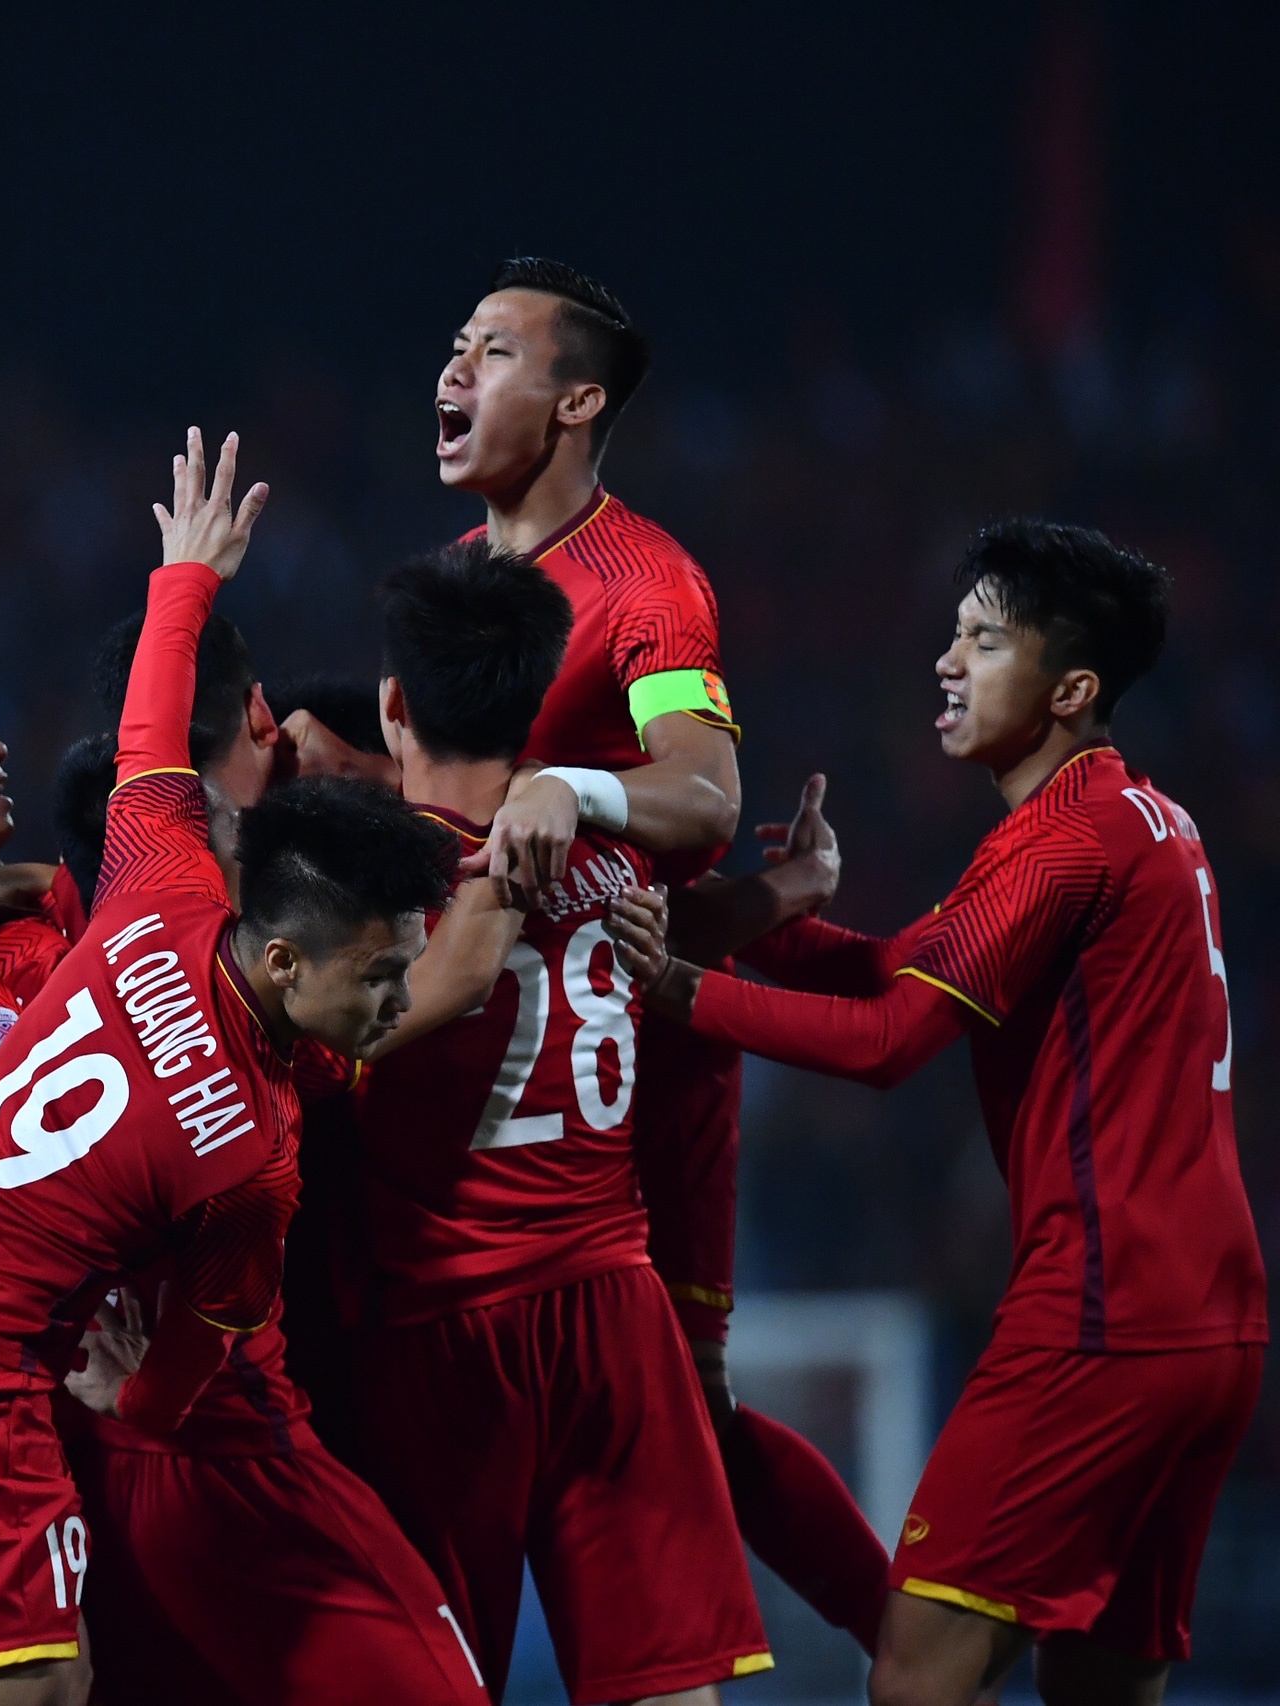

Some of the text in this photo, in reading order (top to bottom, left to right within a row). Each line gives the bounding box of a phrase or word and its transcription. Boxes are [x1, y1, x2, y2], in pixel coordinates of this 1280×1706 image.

[102, 913, 255, 1158] N. QUANG HAI
[463, 919, 635, 1150] 28
[45, 1515, 87, 1609] 19
